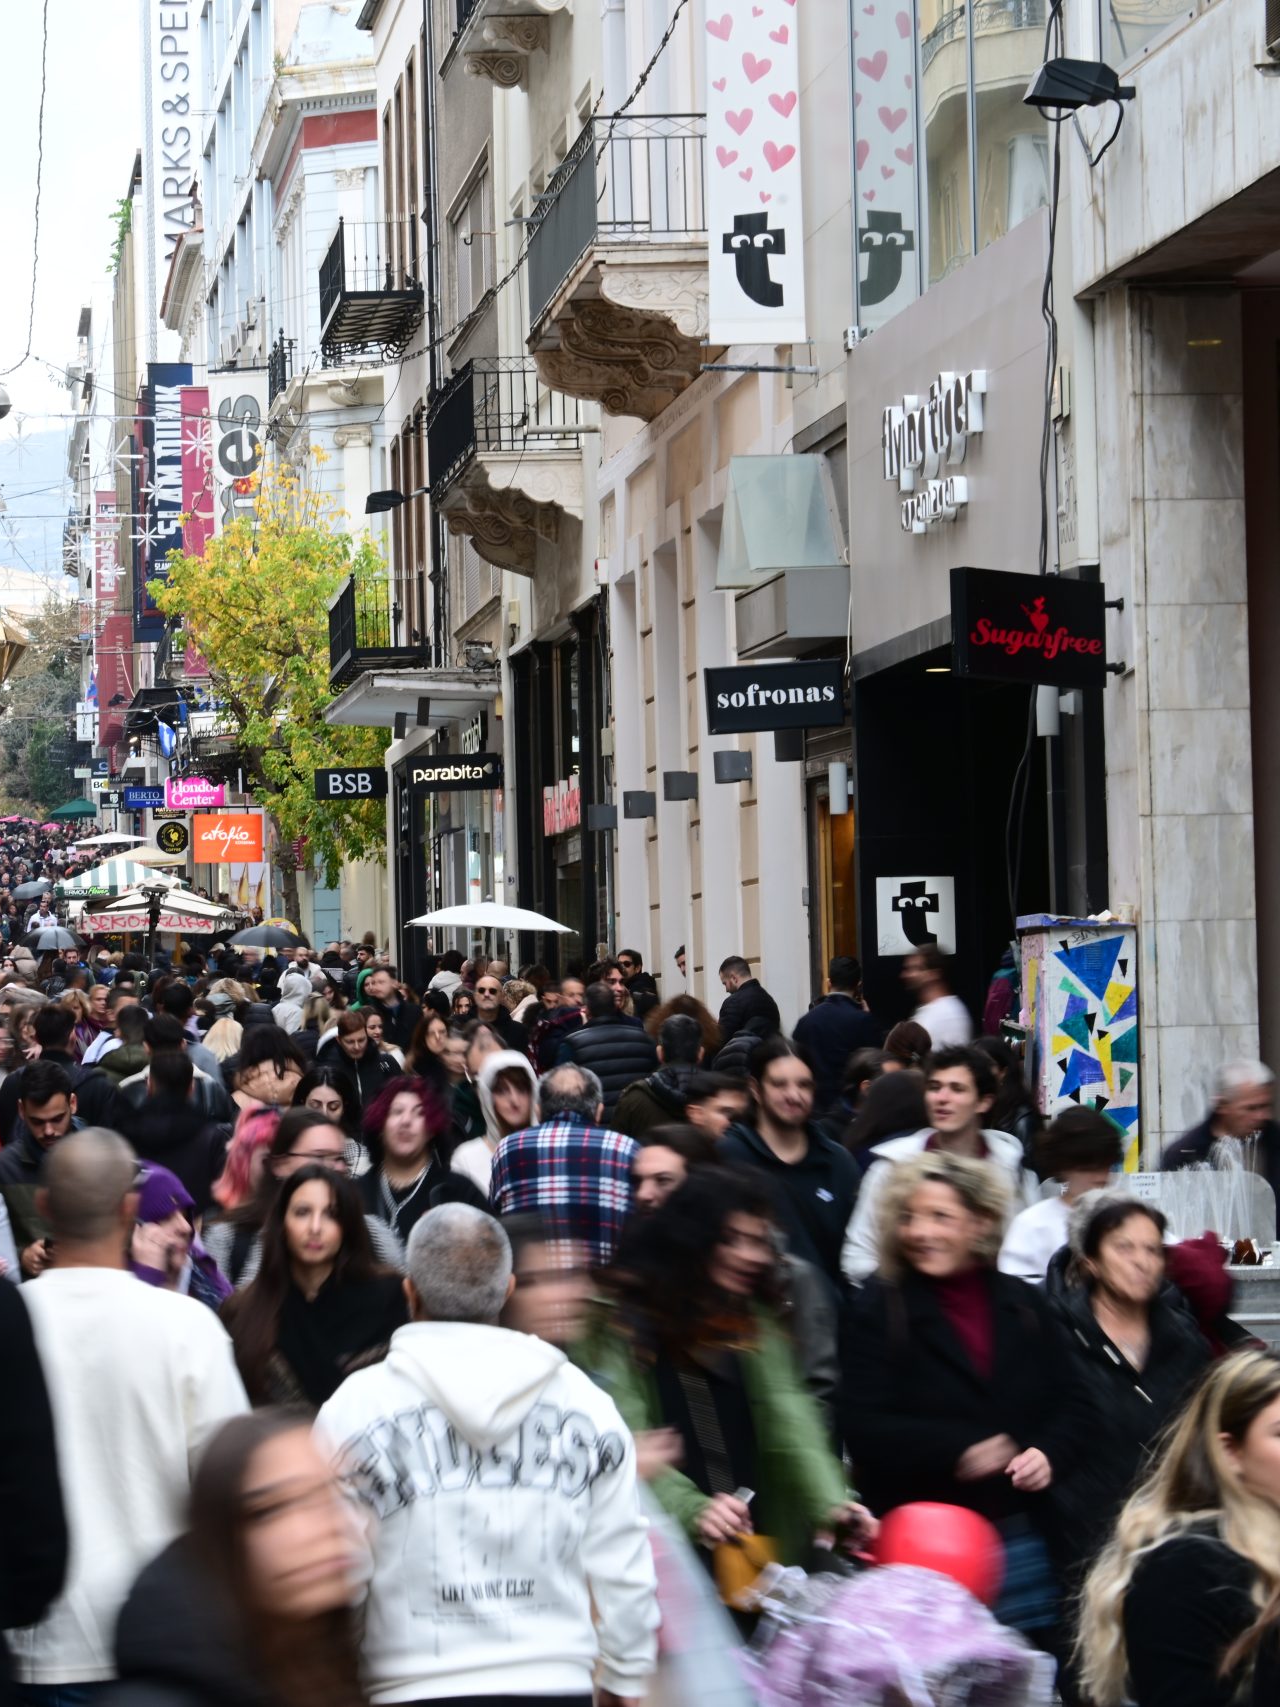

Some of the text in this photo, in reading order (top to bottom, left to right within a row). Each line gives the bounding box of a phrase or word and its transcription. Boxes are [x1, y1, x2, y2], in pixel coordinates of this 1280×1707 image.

[159, 0, 190, 82] SPE
[161, 93, 190, 115] &
[970, 616, 1104, 661] Sugarfree
[716, 682, 836, 710] sofronas
[328, 773, 372, 795] BSB
[413, 763, 483, 785] parabita
[129, 791, 160, 799] BERTO
[171, 793, 216, 806] Center
